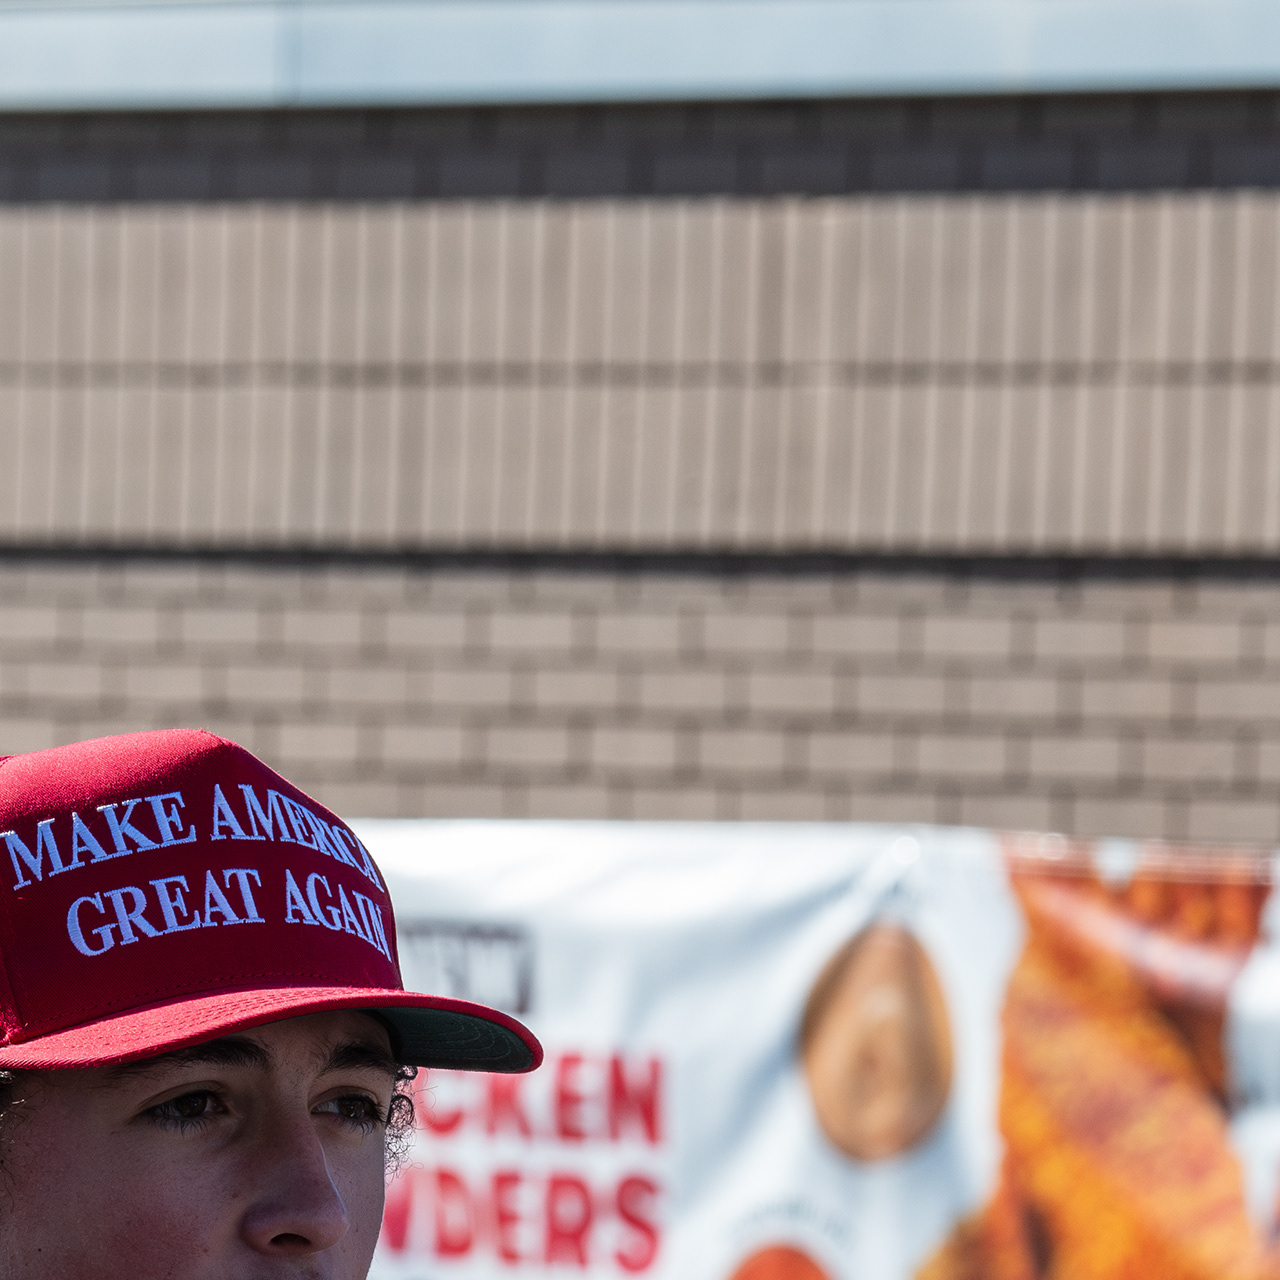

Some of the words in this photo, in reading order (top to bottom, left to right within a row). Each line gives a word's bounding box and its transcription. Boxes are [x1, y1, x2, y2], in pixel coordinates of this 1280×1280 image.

[210, 783, 385, 893] AMERICA
[66, 867, 266, 957] GREAT
[284, 868, 392, 964] AGAIN
[403, 1050, 665, 1145] CKEN
